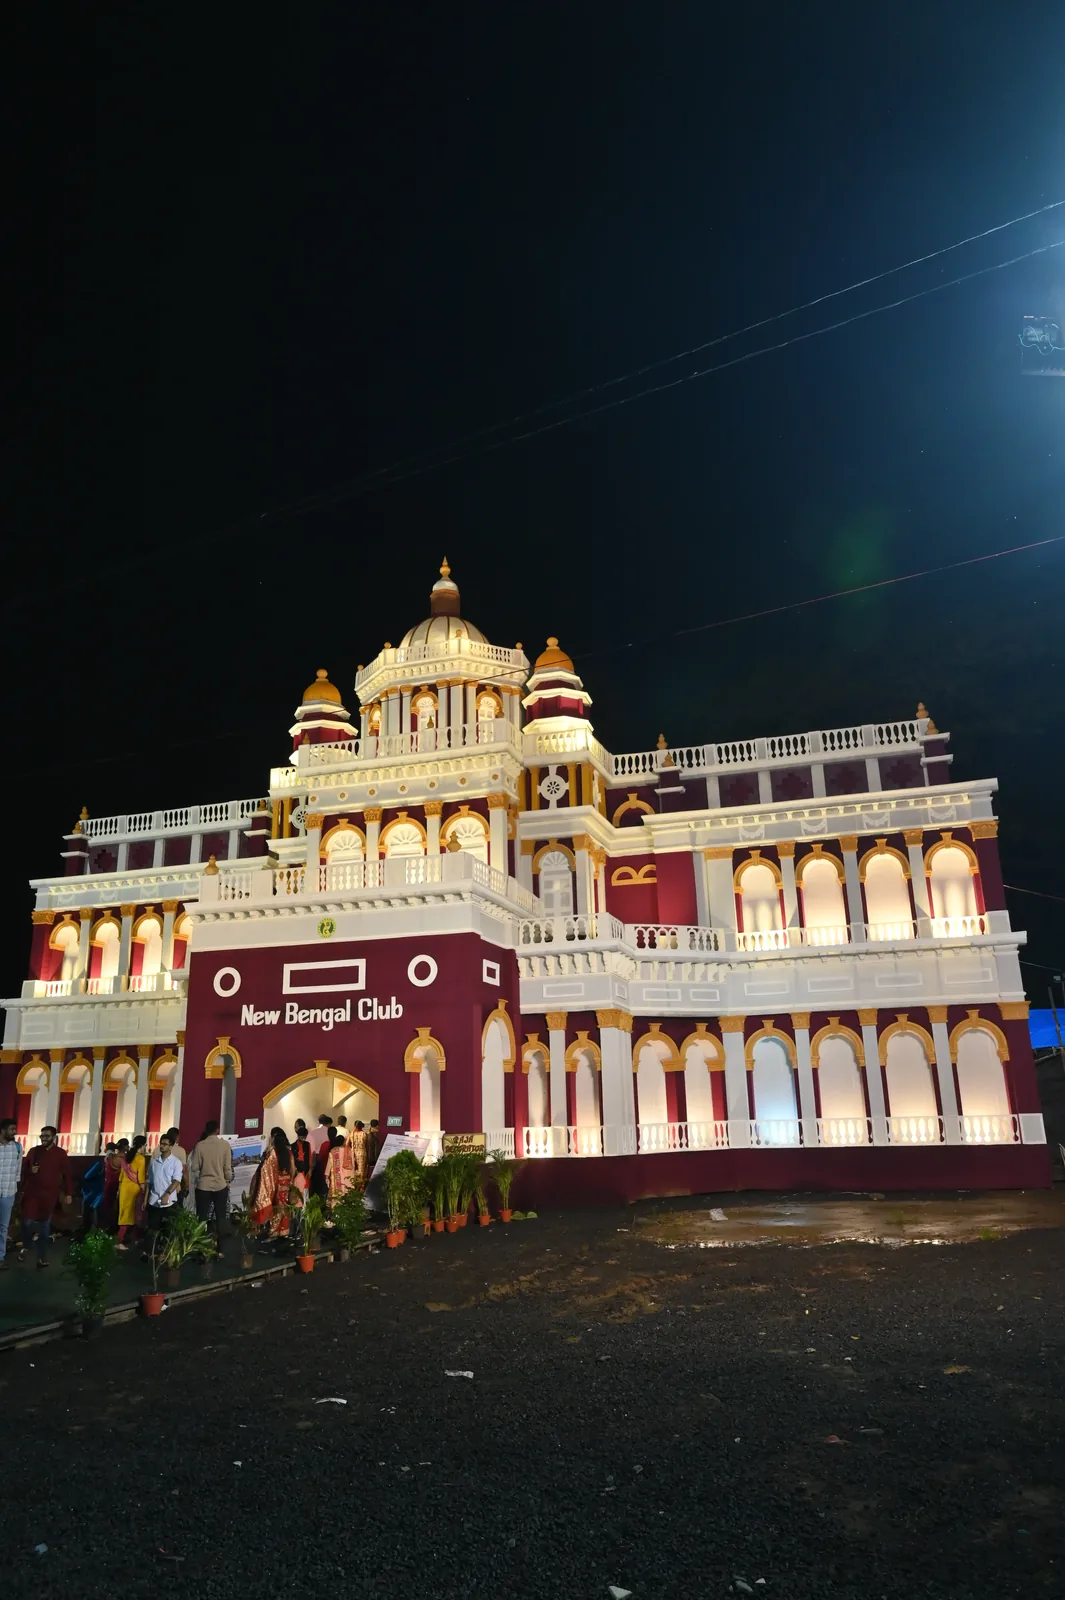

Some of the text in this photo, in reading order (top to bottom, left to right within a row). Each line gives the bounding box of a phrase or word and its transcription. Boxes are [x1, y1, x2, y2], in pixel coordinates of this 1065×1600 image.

[241, 996, 403, 1031] New Bengal Club
[453, 1135, 474, 1144] RAJA
